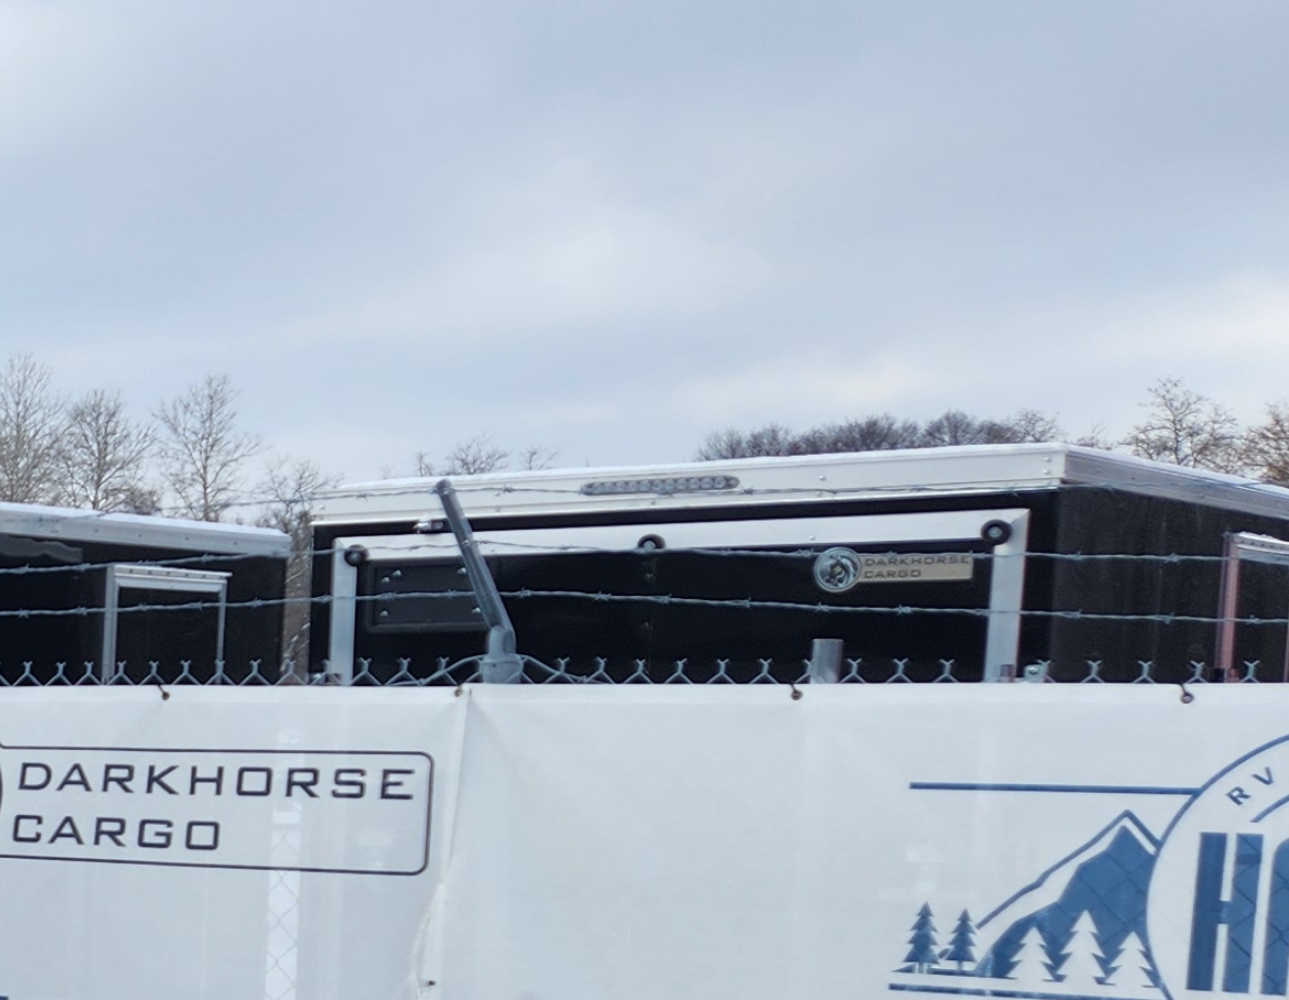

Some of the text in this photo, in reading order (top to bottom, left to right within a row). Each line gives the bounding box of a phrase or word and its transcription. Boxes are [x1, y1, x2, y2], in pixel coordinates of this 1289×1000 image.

[864, 555, 970, 567] DARKHORSE
[864, 569, 921, 579] CARGO
[17, 761, 416, 801] DARKHORSE
[1225, 766, 1275, 806] RV
[12, 813, 221, 851] CARGO
